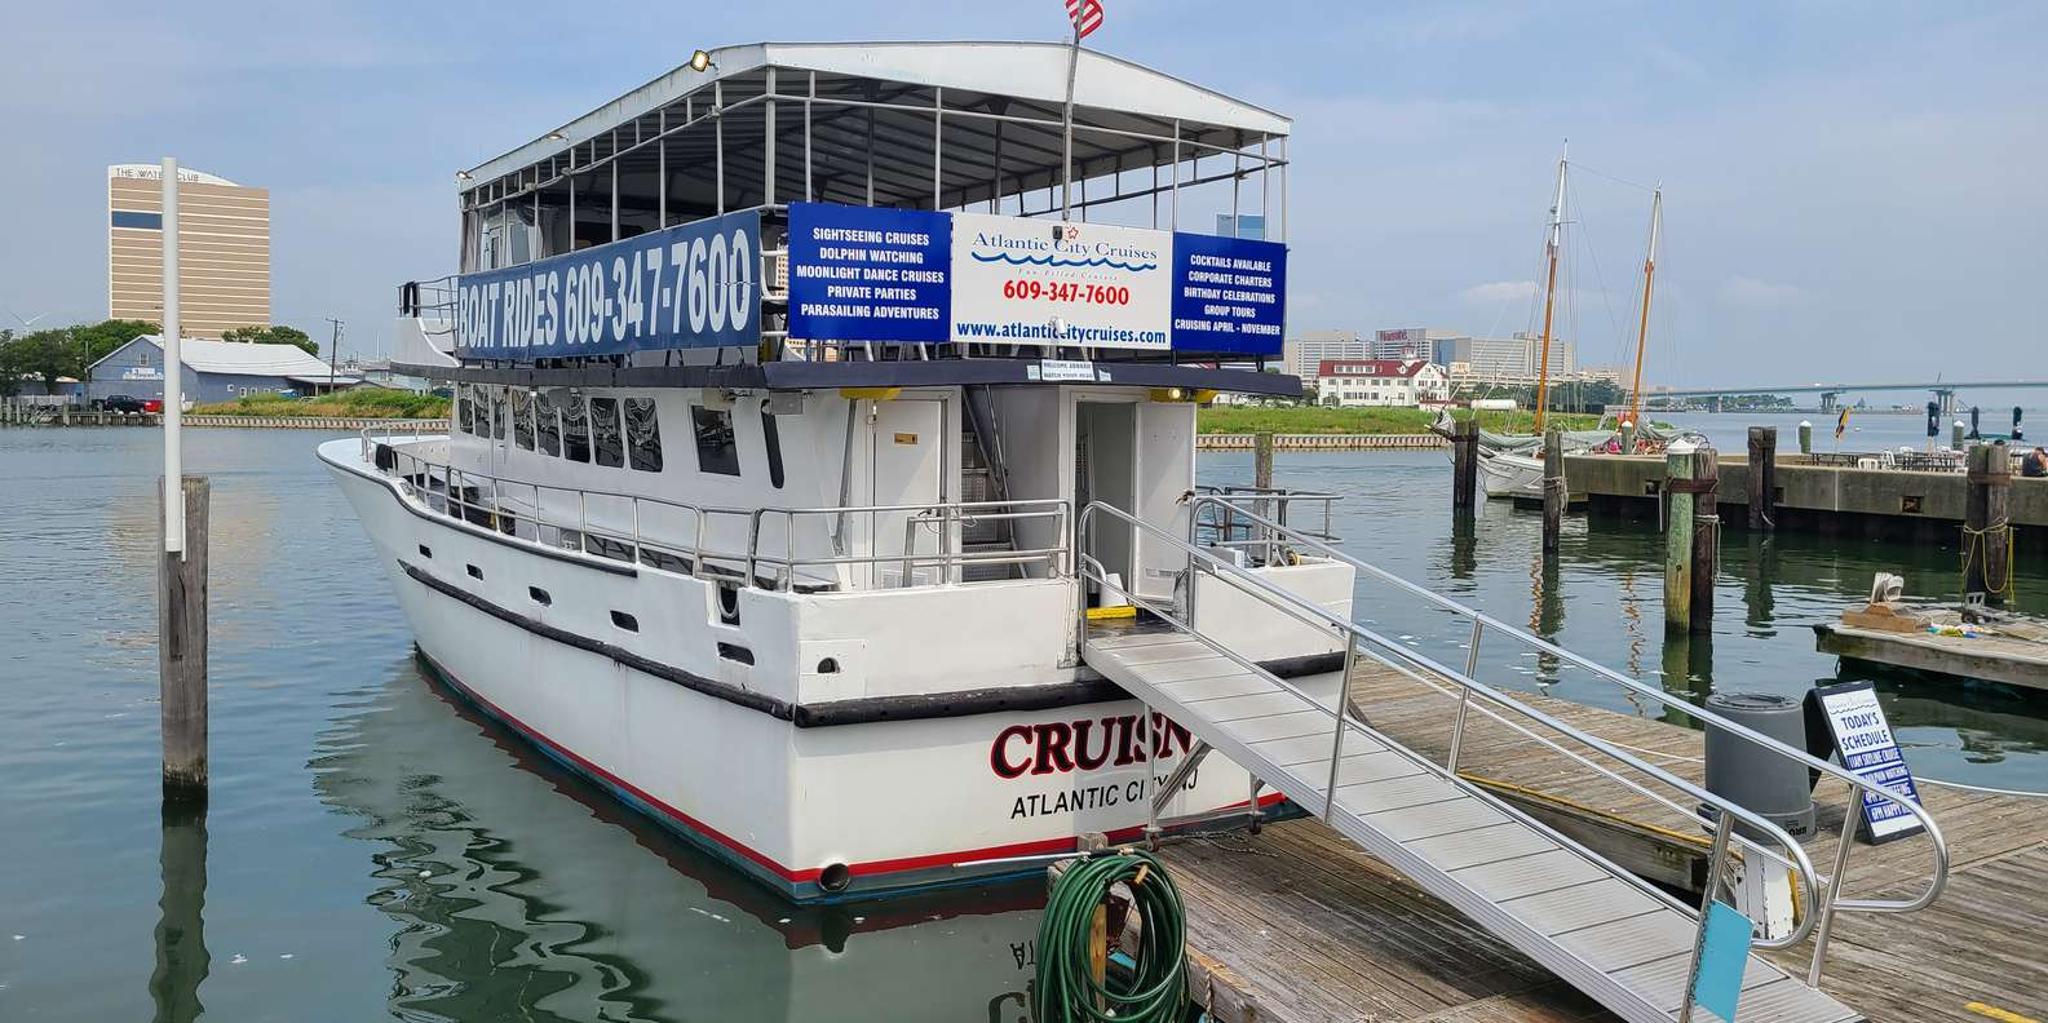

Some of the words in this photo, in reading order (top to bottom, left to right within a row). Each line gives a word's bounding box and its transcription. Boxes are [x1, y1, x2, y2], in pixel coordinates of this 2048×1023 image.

[116, 168, 134, 177] THE
[813, 227, 883, 244] SIGHTSEEING
[885, 231, 930, 246] CRUISES
[972, 231, 1048, 251] Atlantic
[1054, 236, 1091, 256] City
[1095, 243, 1157, 260] Cruises
[820, 247, 867, 262] DOLPHIN
[869, 249, 924, 264] WATCHING
[1190, 255, 1232, 269] COCKTAILS
[1233, 258, 1271, 272] AVAILABLE
[797, 265, 861, 281] MOONLIGHT
[863, 268, 899, 282] DANCE
[901, 269, 944, 283] CRUISES
[1188, 271, 1233, 285] CORPORATE
[1234, 274, 1272, 288] CHARTERS
[458, 282, 500, 348] BOAT
[502, 269, 558, 348] RIDES
[565, 228, 751, 345] 609-347-7600
[827, 286, 871, 299] PRIVATE
[874, 287, 916, 301] PARTIES
[1004, 280, 1129, 305] 609-347-7600
[1184, 287, 1221, 300] BIRTHDAY
[1223, 290, 1276, 304] CELEBRATIONS
[801, 303, 870, 318] PARASAILING
[874, 305, 939, 320] ADVENTURES
[1204, 305, 1230, 318] GROUP
[1232, 306, 1256, 319] TOURS
[1175, 318, 1211, 331] CRUISING
[1212, 321, 1236, 333] APRIL
[1241, 323, 1281, 336] NOVEMBER
[1841, 712, 1880, 730] TODAY'S
[1841, 730, 1890, 752] SCHEDULE
[1011, 783, 1120, 819] ATLANTIC
[1126, 774, 1169, 803] CIY
